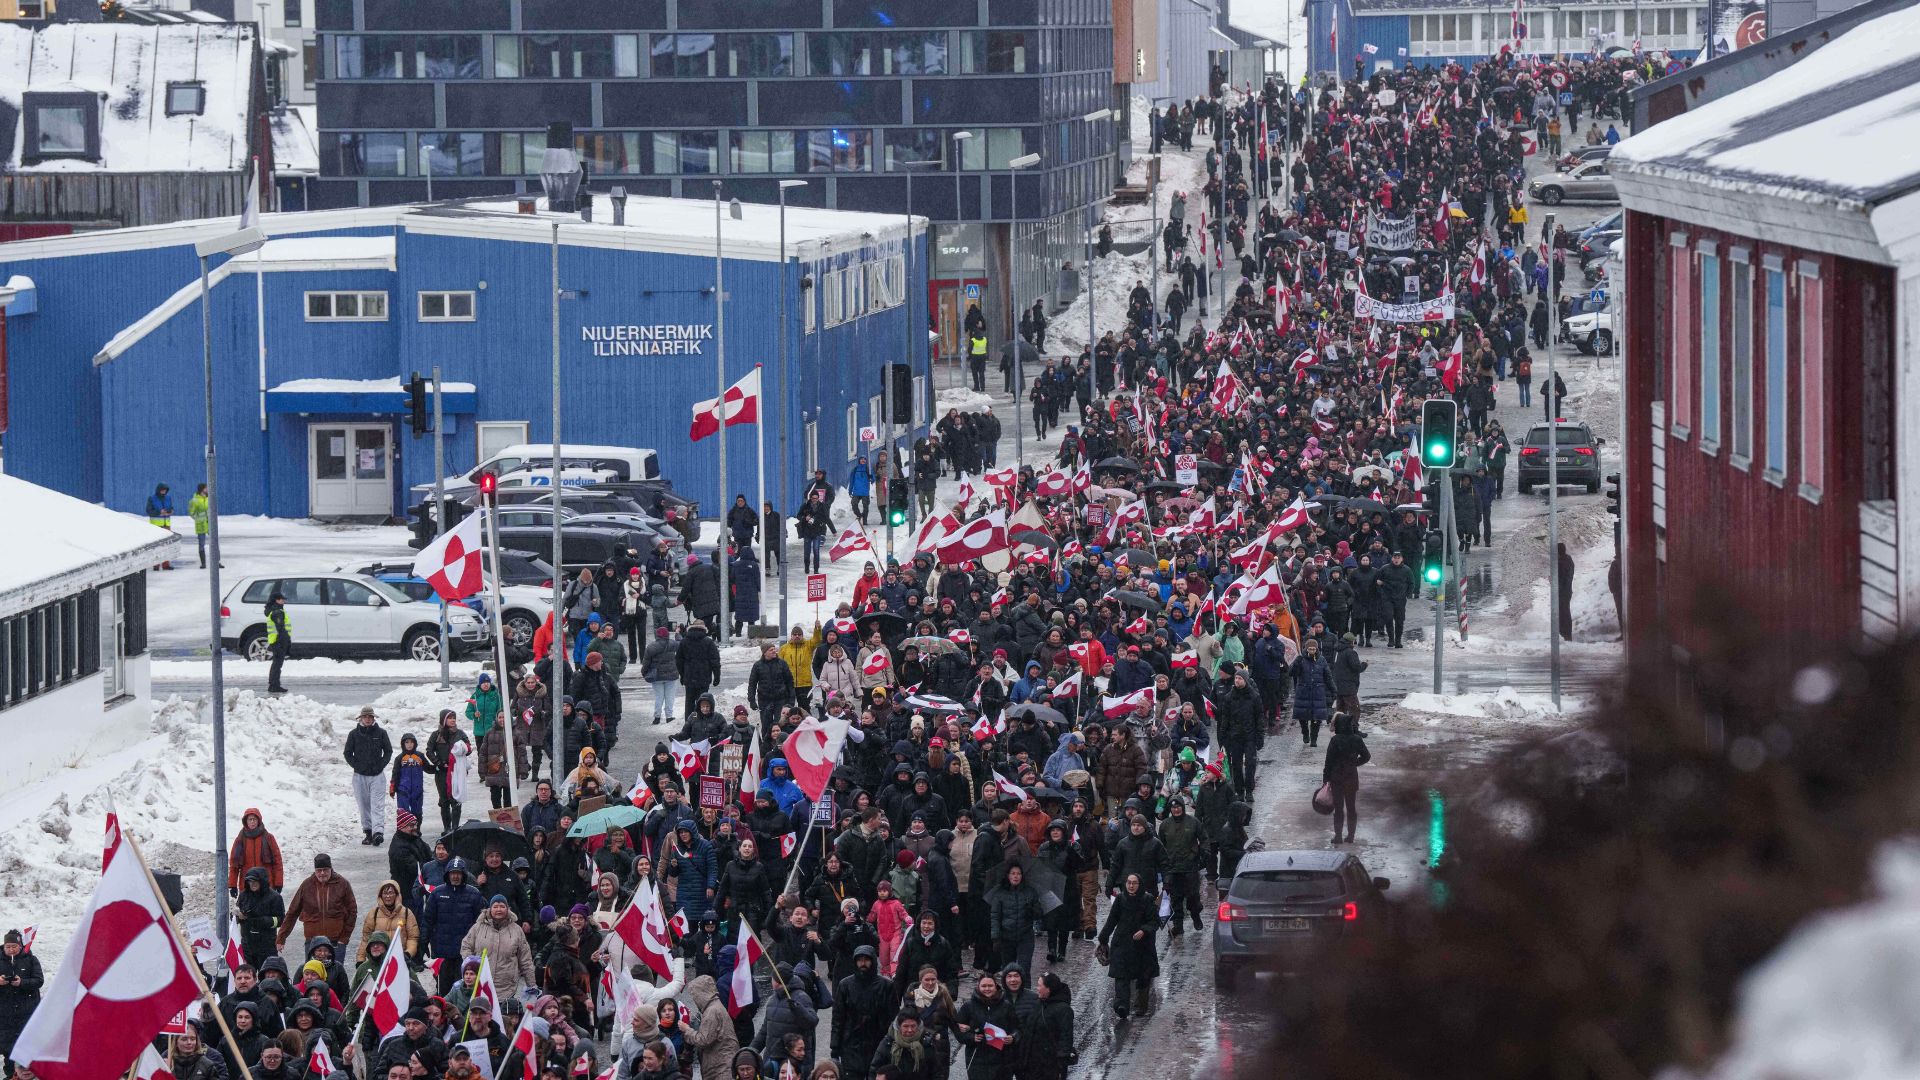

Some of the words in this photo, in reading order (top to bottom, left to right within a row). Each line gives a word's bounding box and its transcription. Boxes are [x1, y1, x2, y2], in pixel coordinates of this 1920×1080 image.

[1370, 231, 1388, 246] GO
[582, 325, 713, 340] NIUERNERMIK
[593, 340, 702, 356] ILINNIARFIK
[702, 795, 722, 806] SALE!
